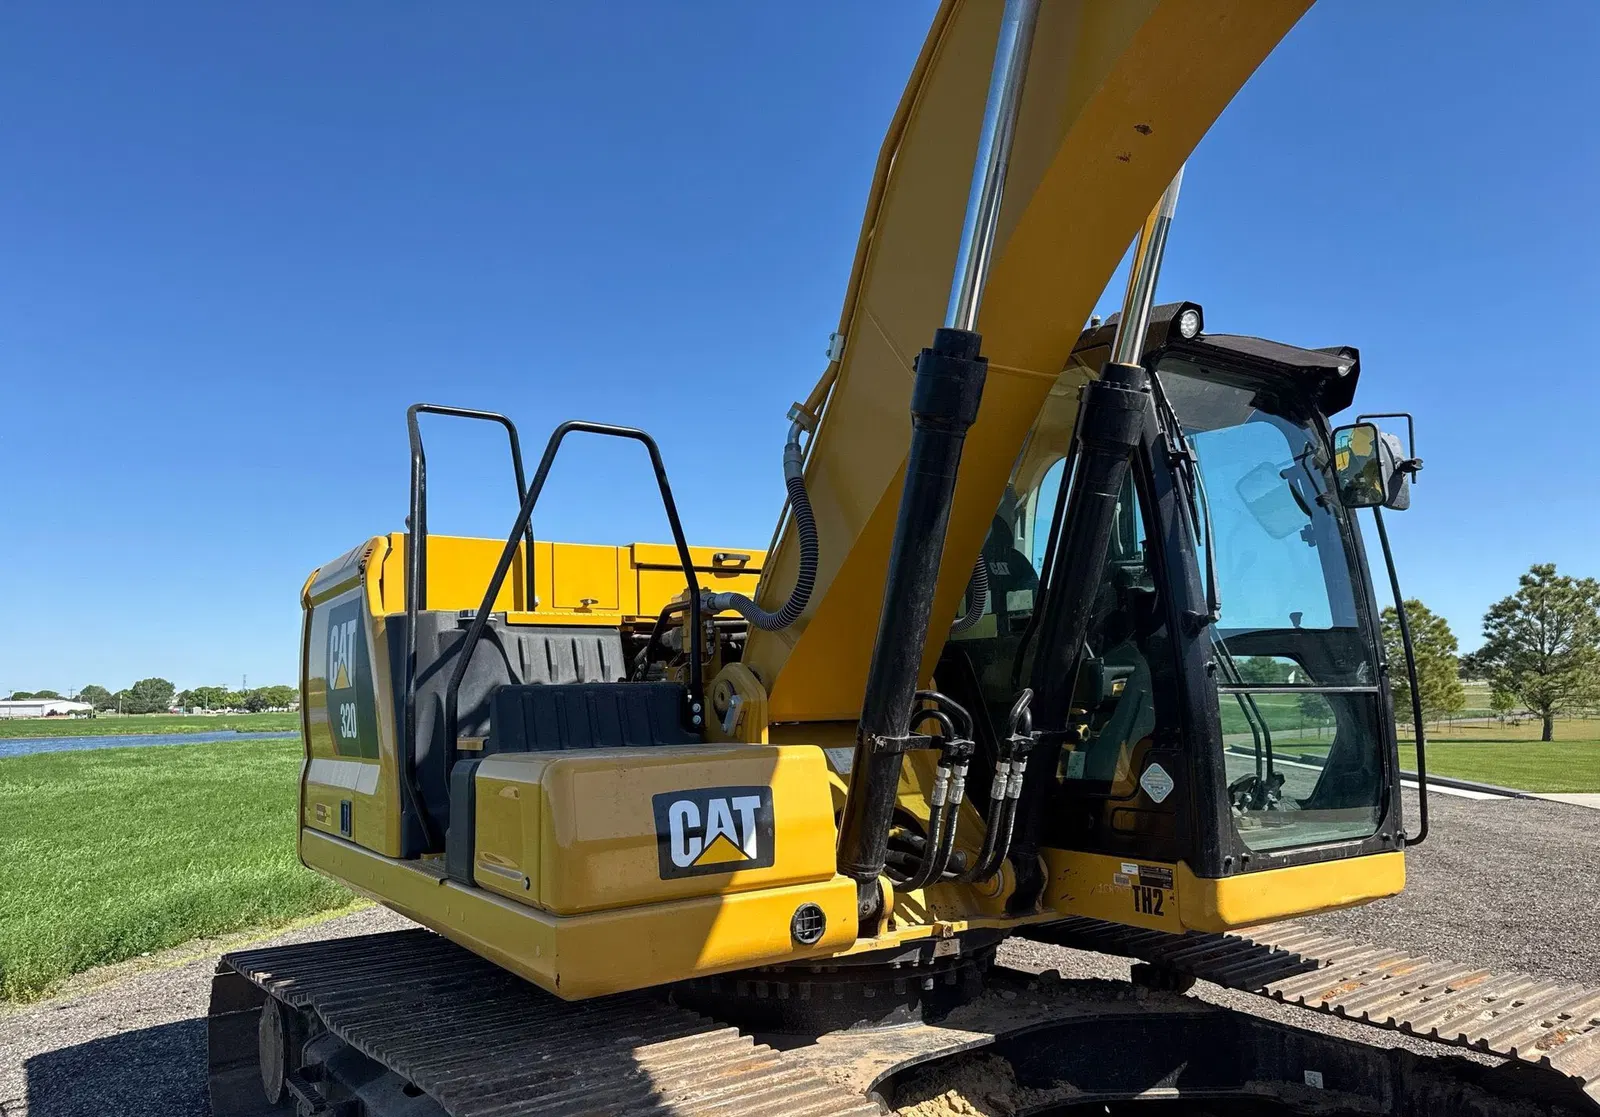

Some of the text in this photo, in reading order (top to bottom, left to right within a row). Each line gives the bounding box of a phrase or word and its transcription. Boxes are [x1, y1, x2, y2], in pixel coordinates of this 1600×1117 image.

[989, 561, 1011, 576] CAT
[329, 619, 357, 690] CAT
[340, 702, 357, 738] 320
[668, 795, 761, 868] CAT
[1132, 885, 1164, 917] TH2
